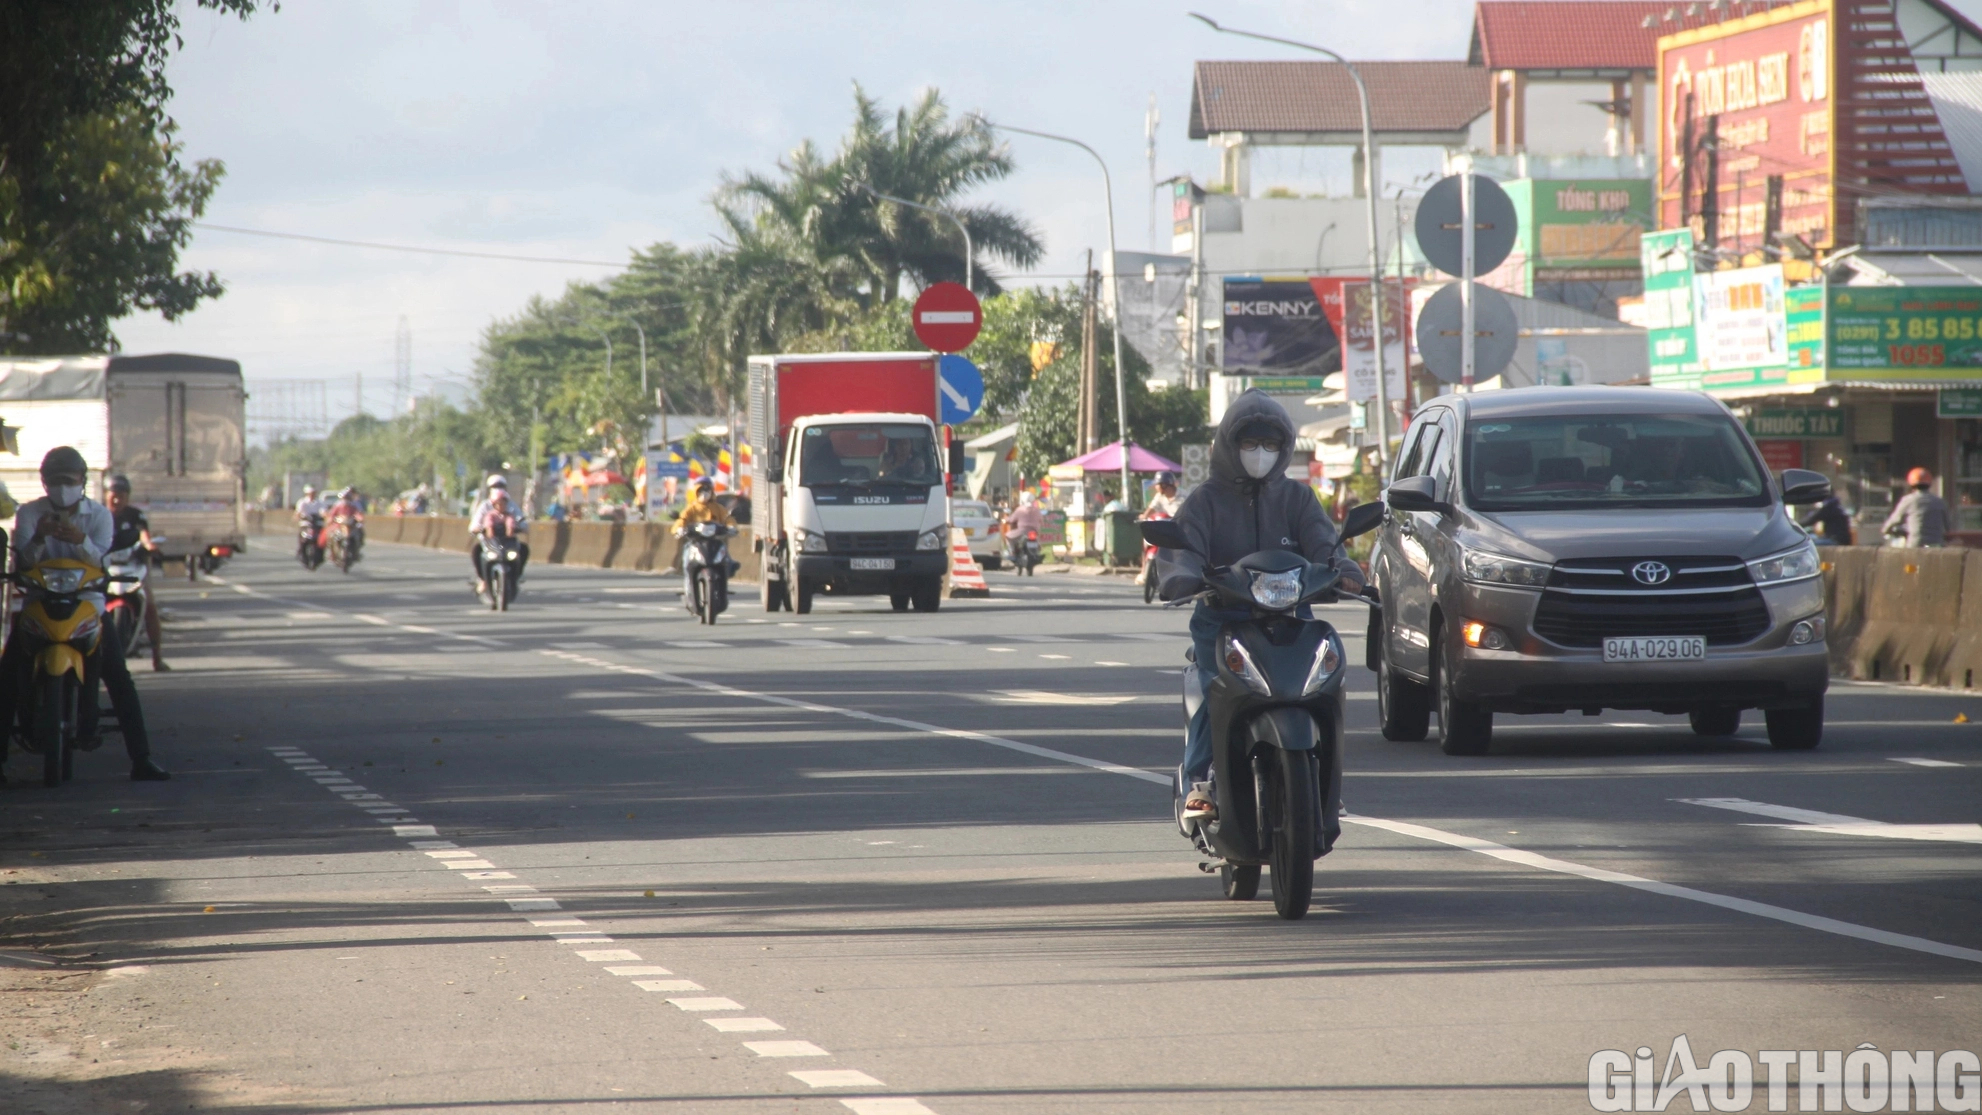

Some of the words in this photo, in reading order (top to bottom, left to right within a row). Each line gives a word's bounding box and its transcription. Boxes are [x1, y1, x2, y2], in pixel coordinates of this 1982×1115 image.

[1241, 301, 1314, 315] KENNY
[1885, 318, 1900, 339] 3
[1887, 344, 1945, 365] 1055
[853, 496, 890, 504] ISUZU
[1607, 639, 1703, 659] 94A-029.06
